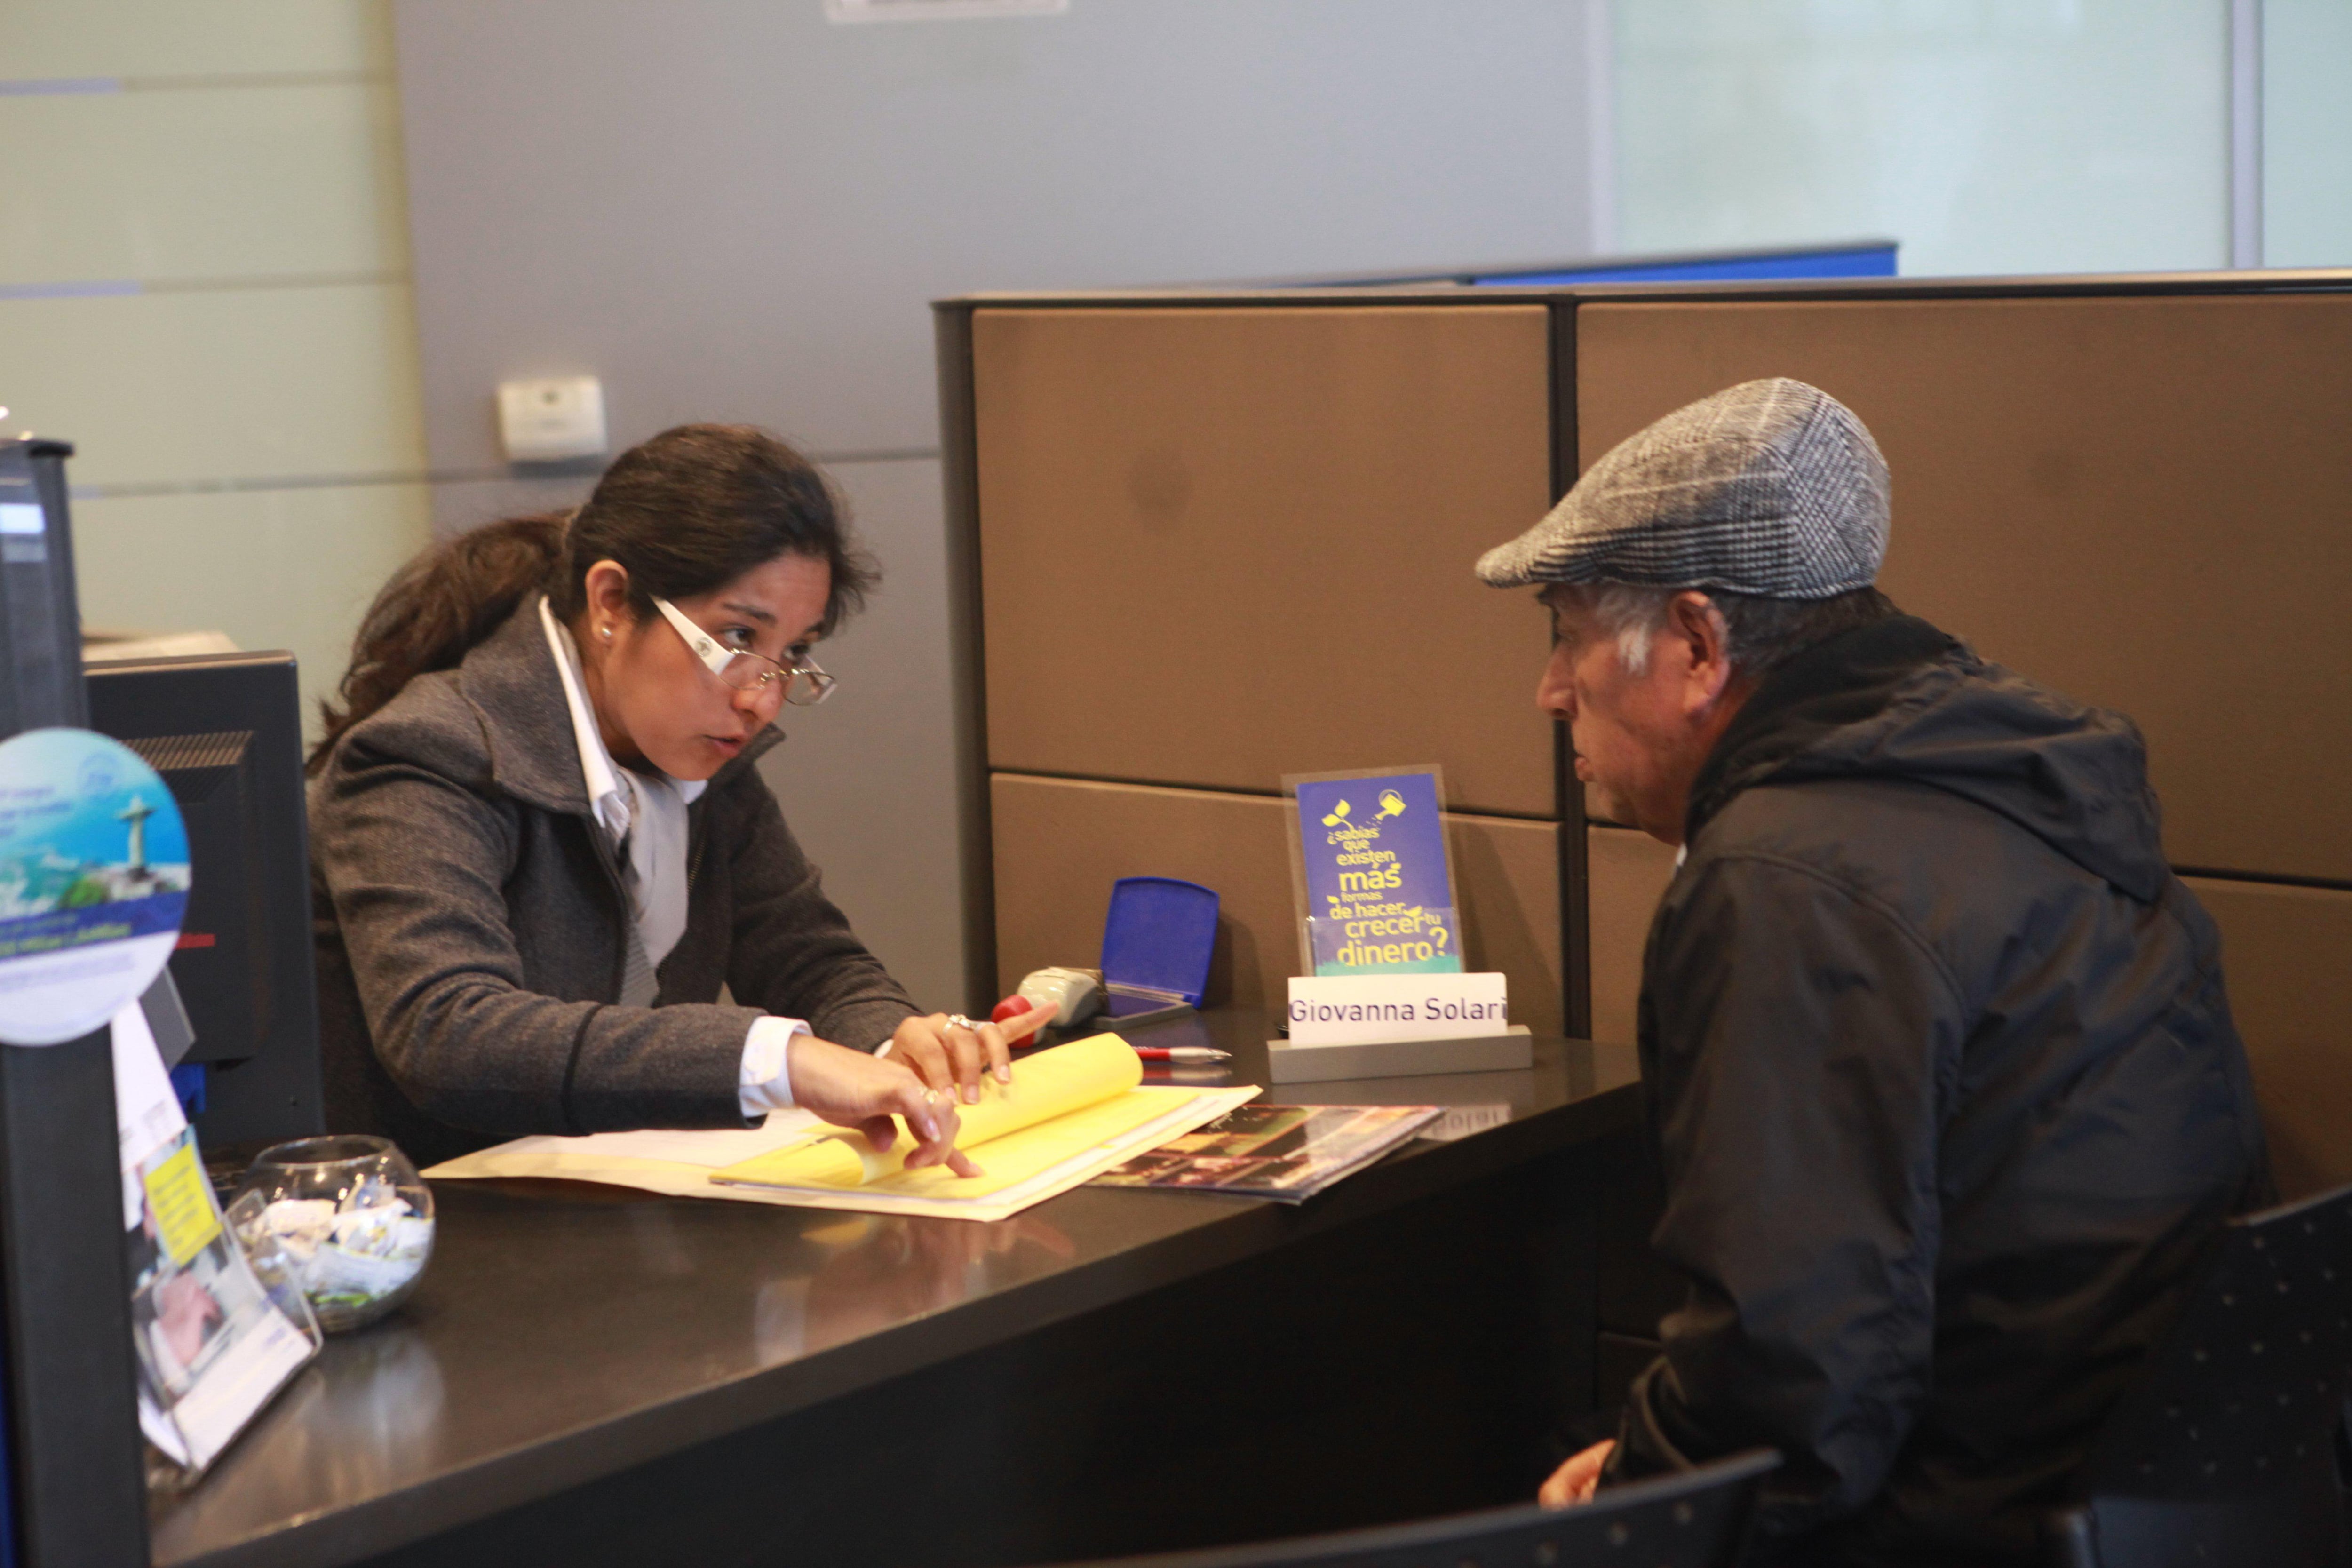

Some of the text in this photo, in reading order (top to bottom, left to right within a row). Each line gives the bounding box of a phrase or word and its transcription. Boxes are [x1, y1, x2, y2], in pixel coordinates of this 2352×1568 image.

[1343, 840, 1370, 853] que
[1336, 850, 1396, 866] existen
[1341, 891, 1383, 903] formas
[1329, 902, 1406, 920] de hacer
[1344, 913, 1442, 939] crecer tu
[1337, 926, 1449, 967] dinero?
[1289, 997, 1508, 1022] Giovanna Solari
